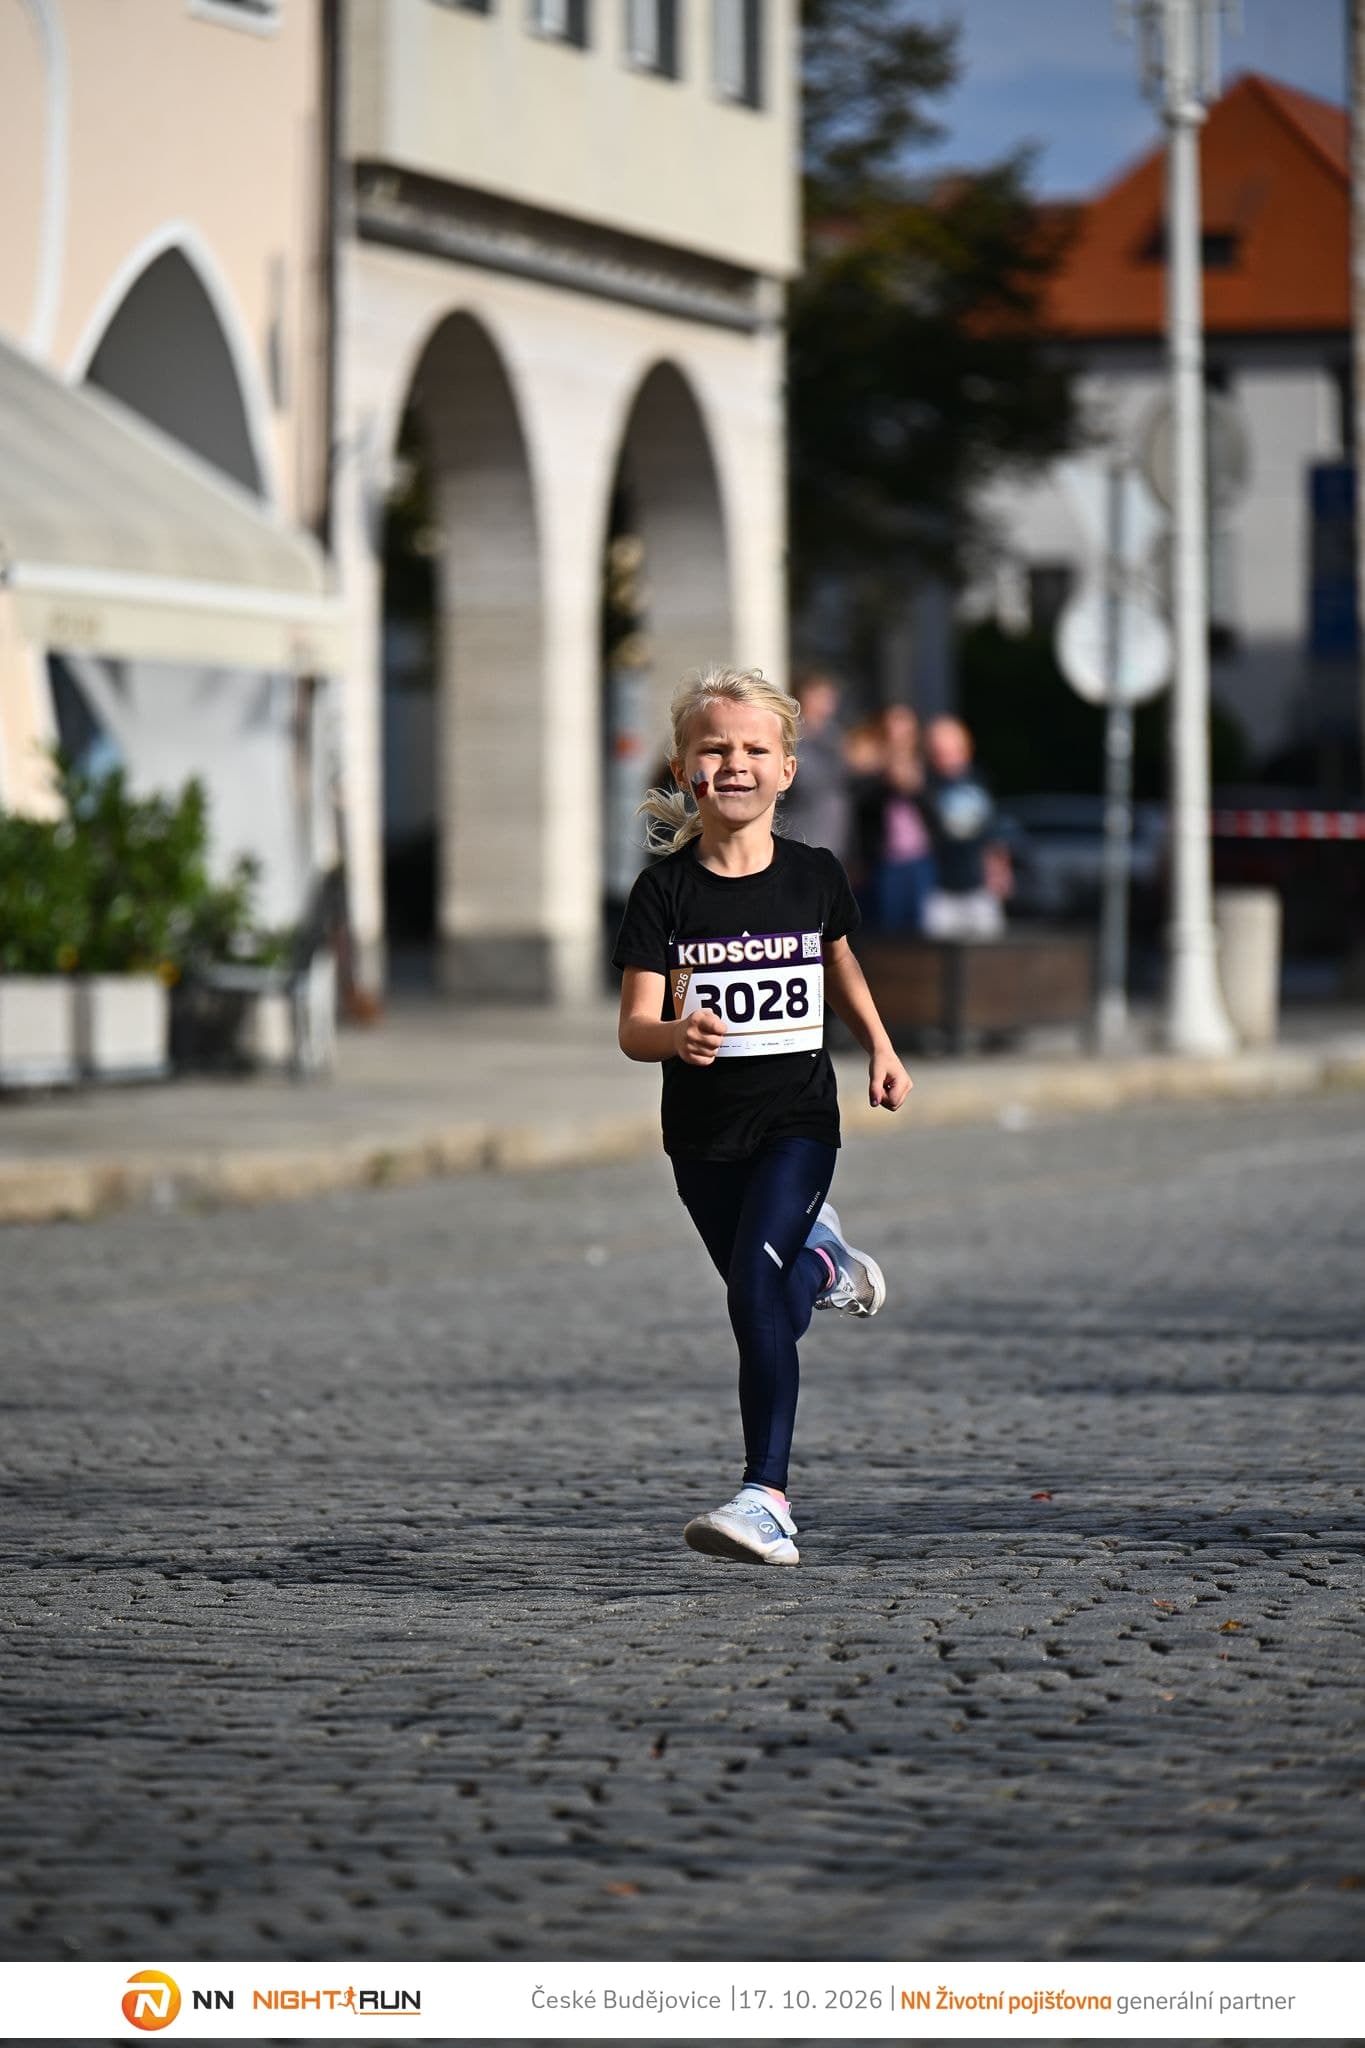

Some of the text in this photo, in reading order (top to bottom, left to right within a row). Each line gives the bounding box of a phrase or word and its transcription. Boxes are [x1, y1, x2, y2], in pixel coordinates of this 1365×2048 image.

[677, 936, 799, 966] KIDSCUP
[674, 972, 689, 1000] 2026
[695, 976, 809, 1024] 3028
